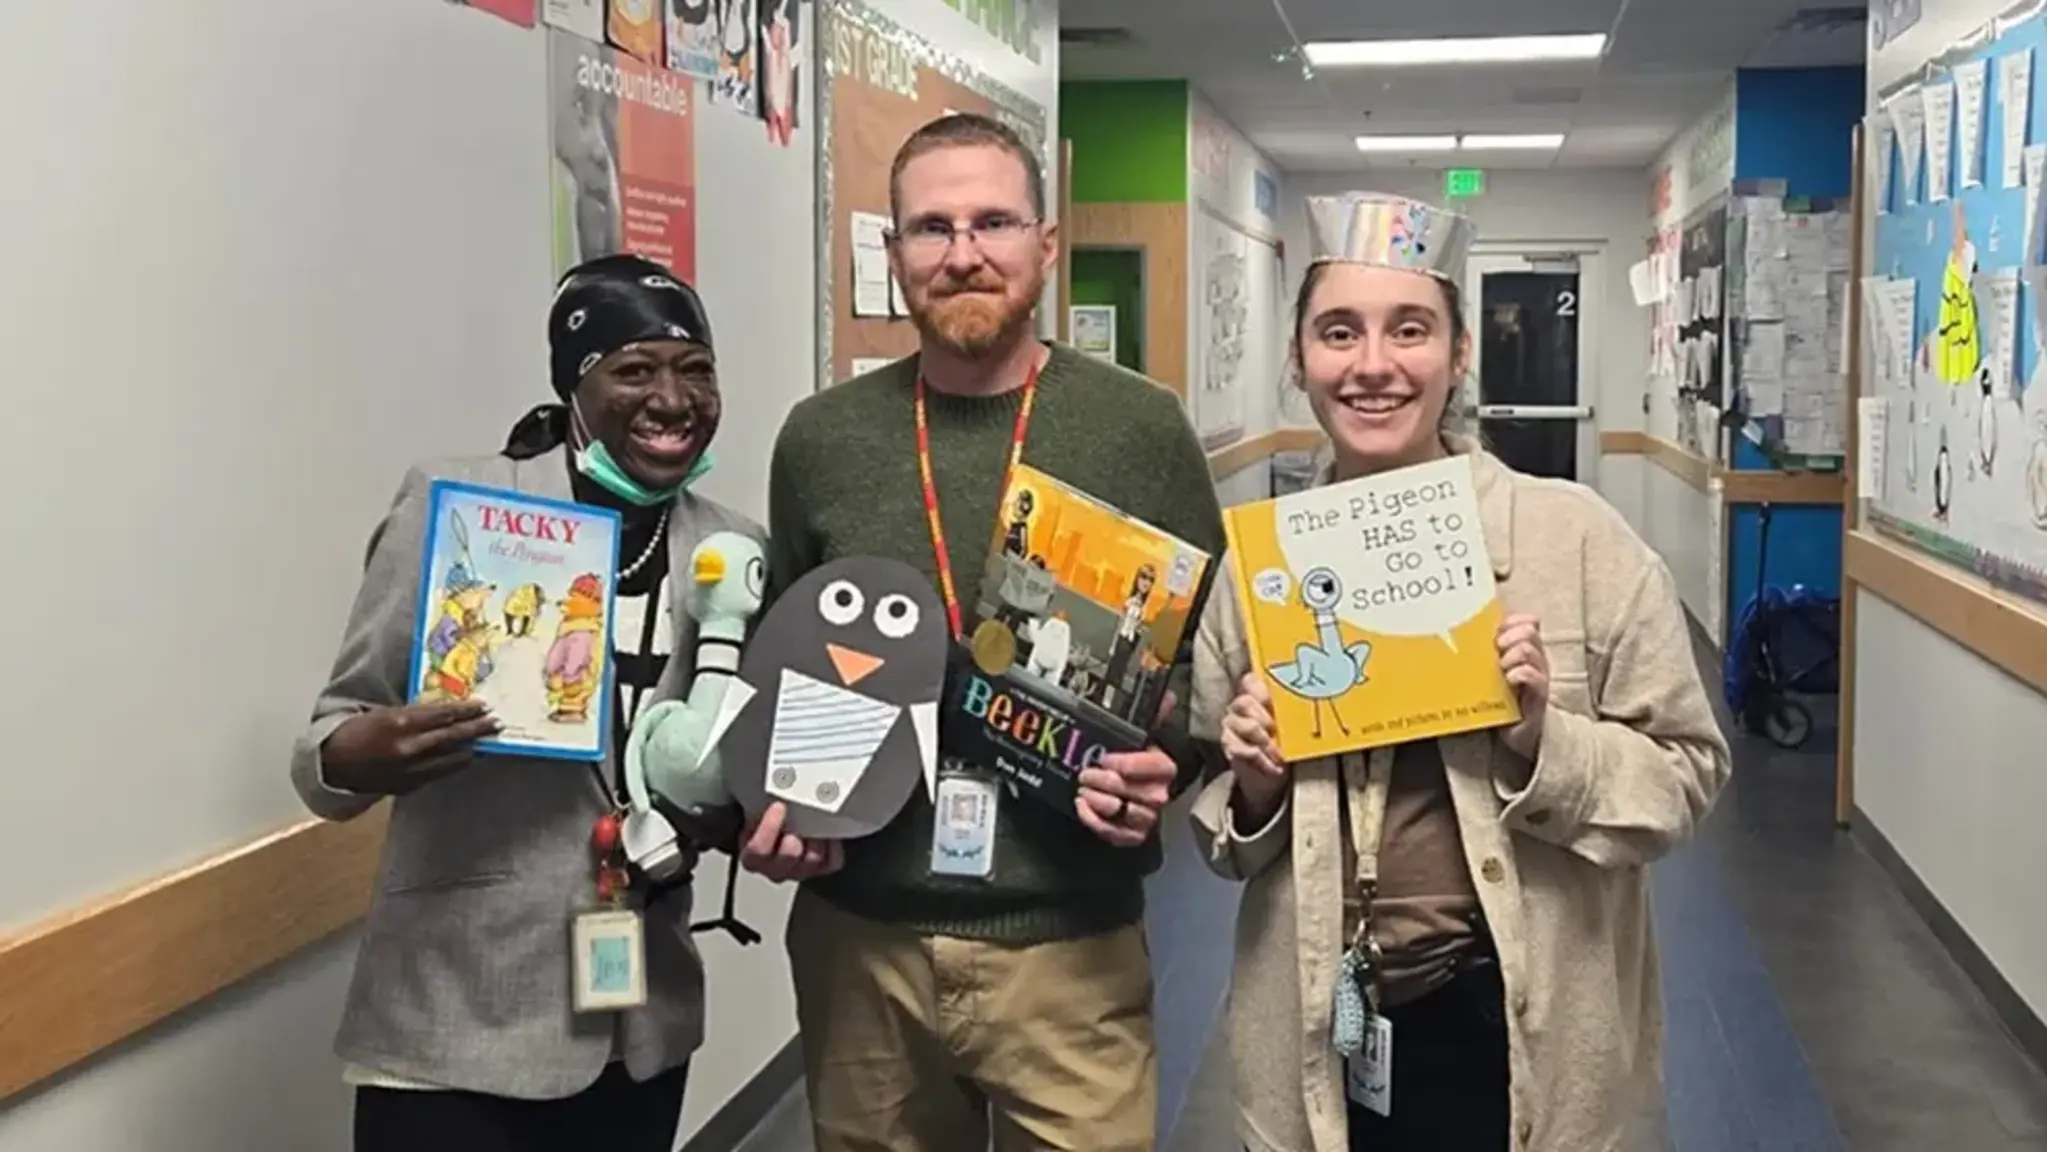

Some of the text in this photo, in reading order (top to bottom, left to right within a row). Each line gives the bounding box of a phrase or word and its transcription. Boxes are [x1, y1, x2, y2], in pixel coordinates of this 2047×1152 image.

[577, 54, 687, 116] accountable
[866, 33, 919, 101] GRADE
[1556, 291, 1576, 316] 2
[477, 505, 581, 544] TACKY
[1288, 480, 1458, 535] The Pigeon
[1361, 513, 1463, 551] HAS to
[1385, 540, 1468, 573] Go to
[1352, 565, 1475, 610] School!
